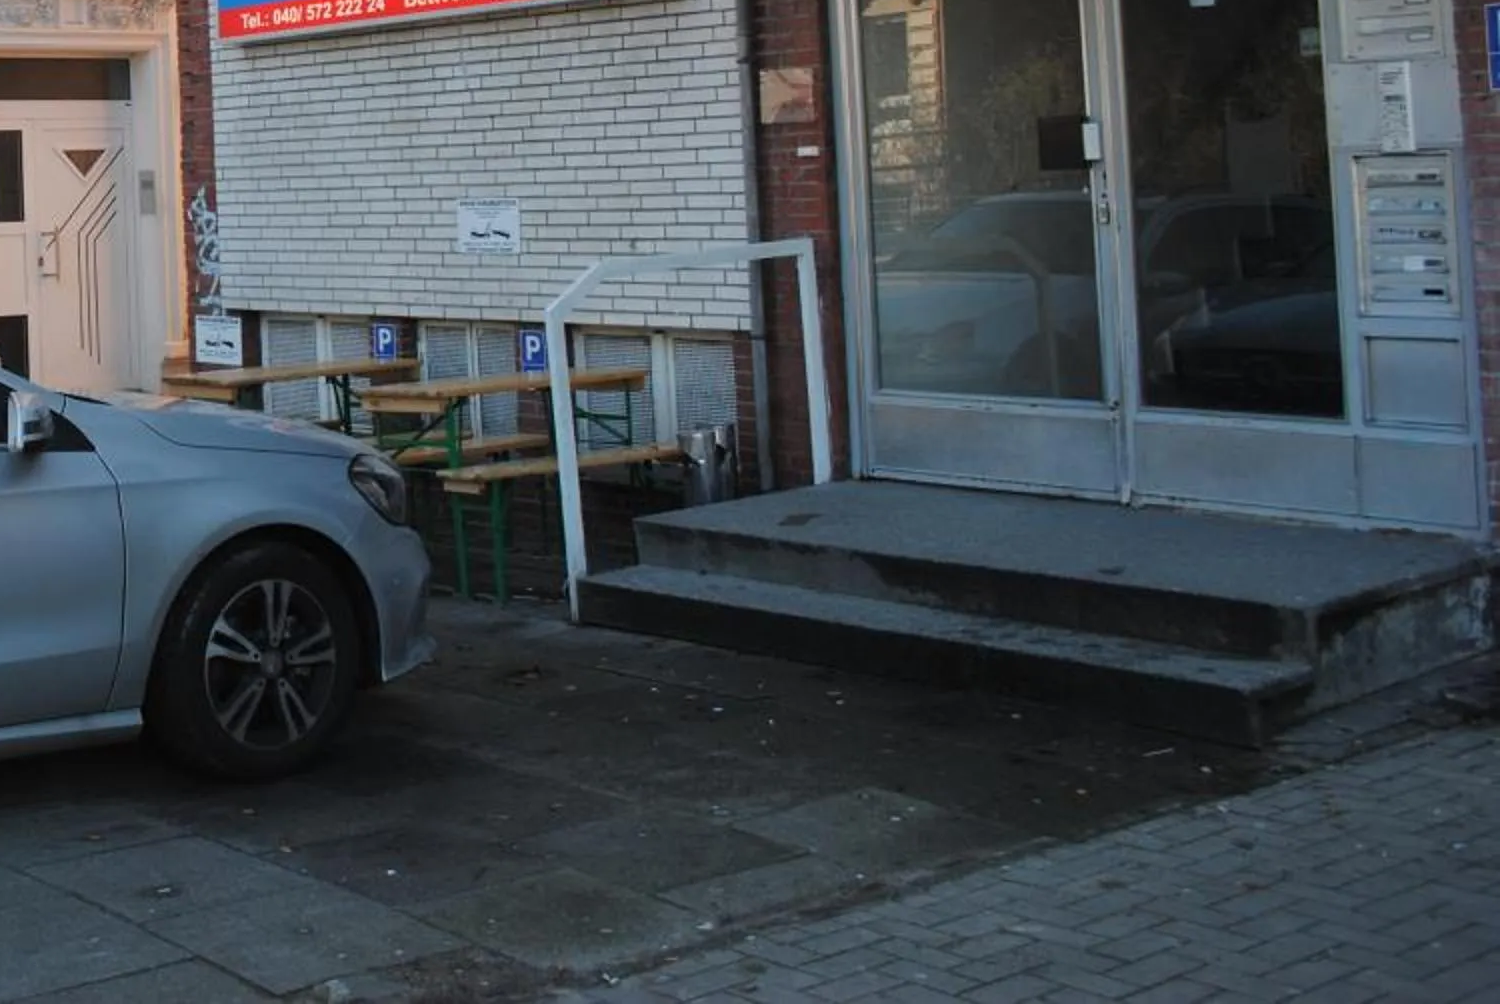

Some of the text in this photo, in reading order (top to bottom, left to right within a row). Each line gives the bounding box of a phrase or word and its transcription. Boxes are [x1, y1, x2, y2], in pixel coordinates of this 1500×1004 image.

[240, 12, 269, 29] Tel.:
[306, 2, 333, 21] 572
[335, 0, 363, 17] 222
[378, 328, 391, 353] P
[525, 335, 541, 361] P
